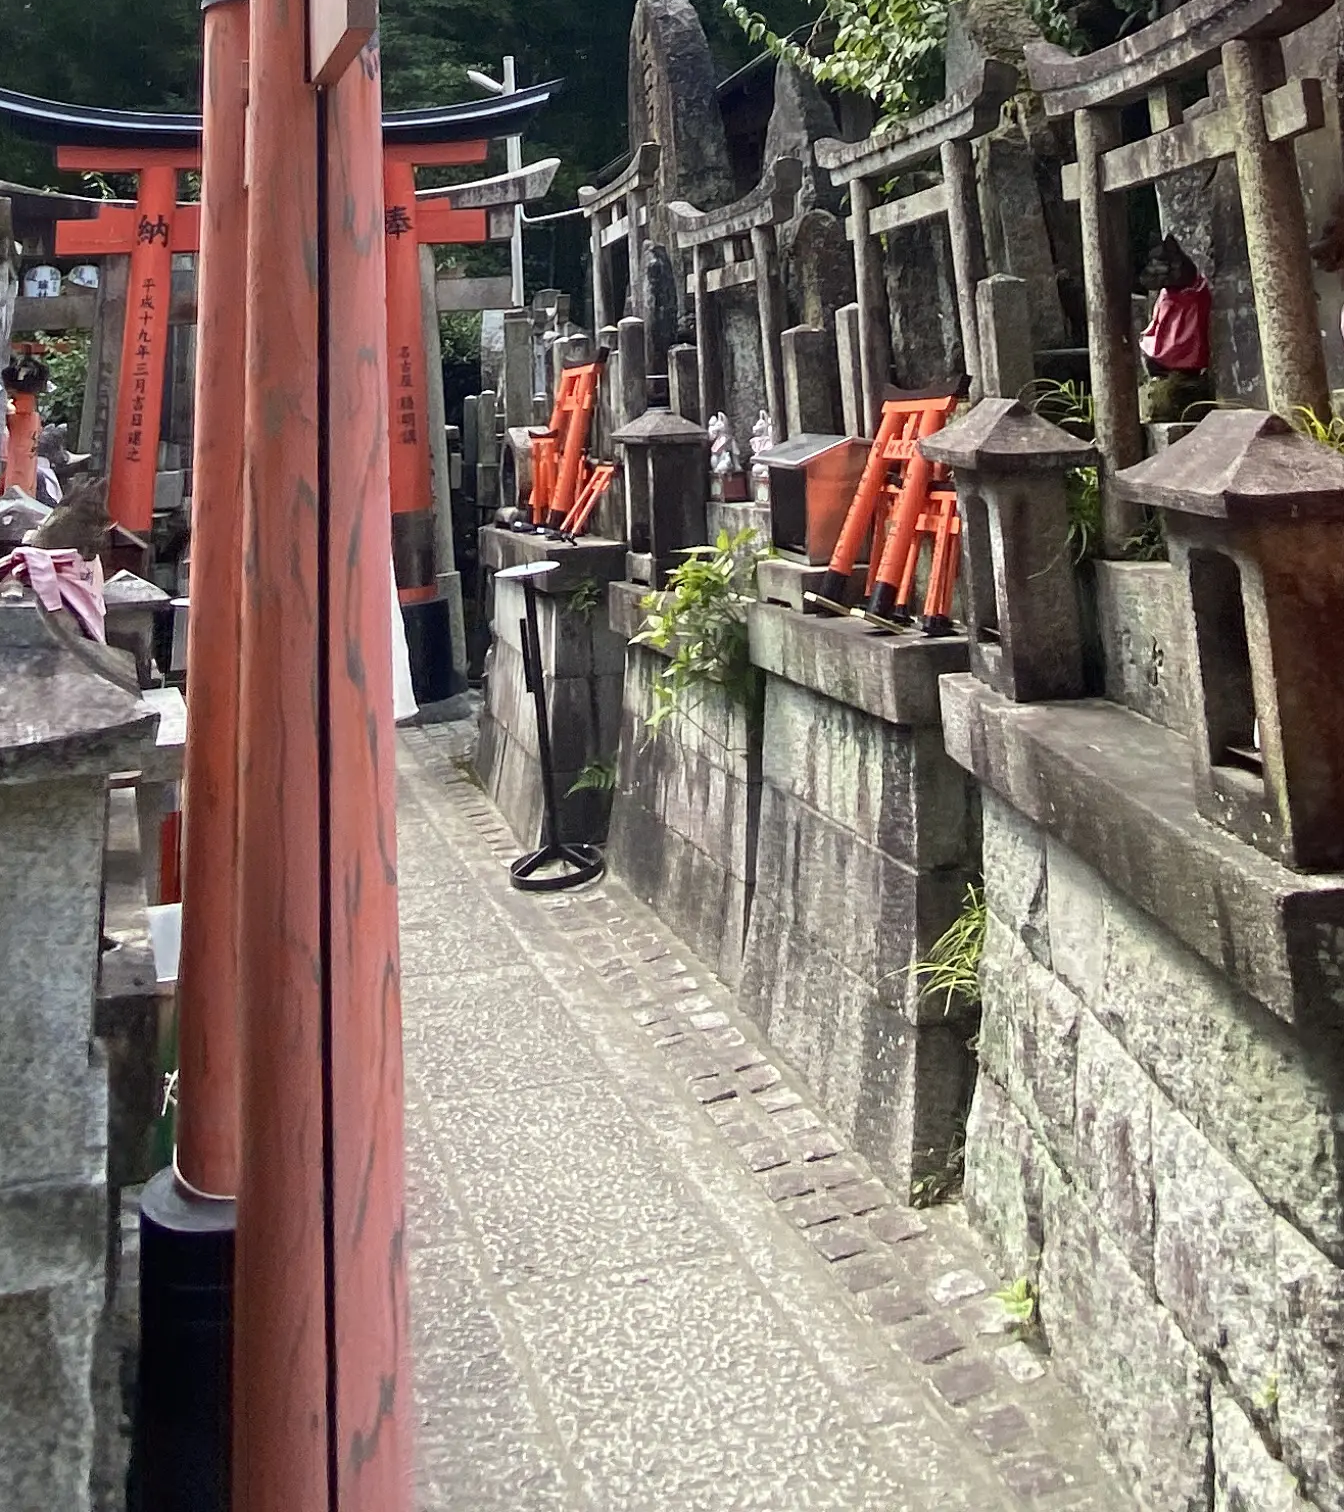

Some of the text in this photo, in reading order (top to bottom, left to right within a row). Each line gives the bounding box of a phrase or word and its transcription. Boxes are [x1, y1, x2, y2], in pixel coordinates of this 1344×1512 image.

[136, 214, 170, 248] 納
[384, 204, 414, 241] 奉
[124, 277, 157, 463] 平成十九年三月吉日建之
